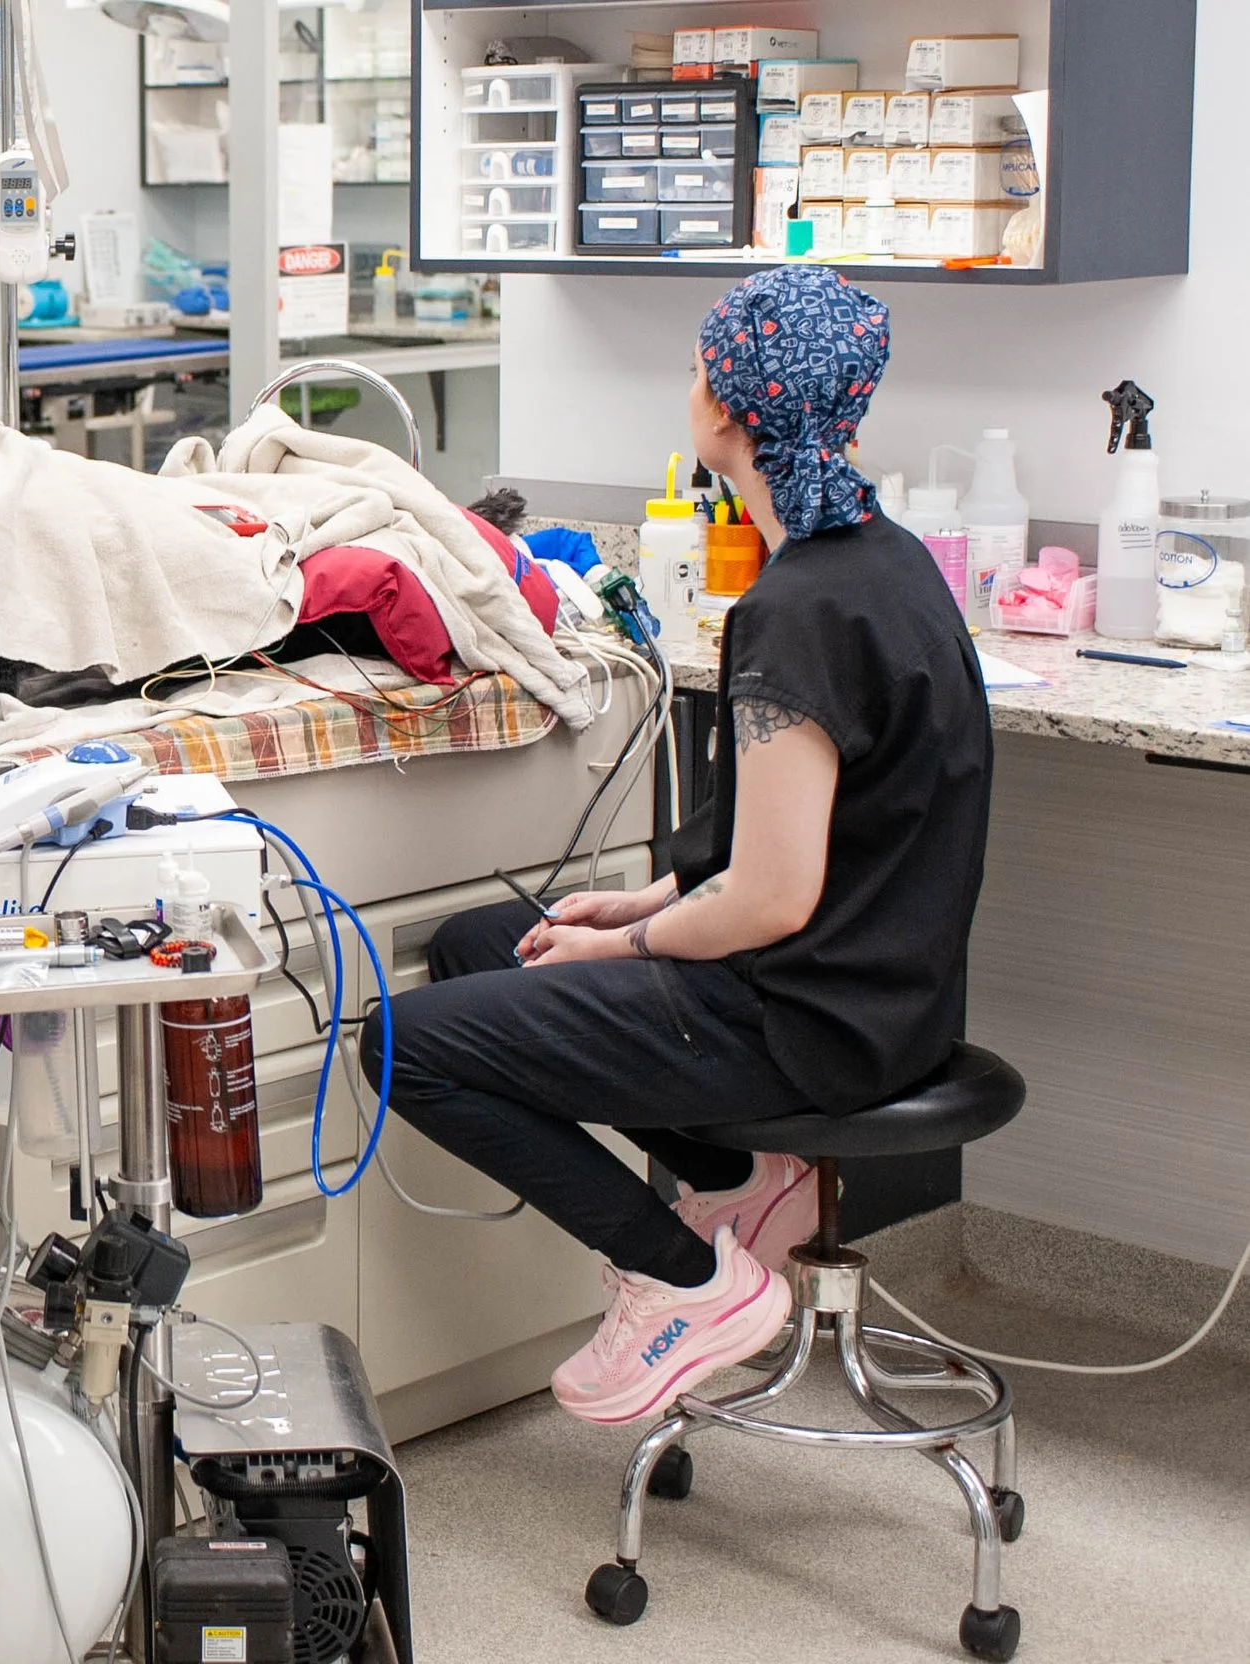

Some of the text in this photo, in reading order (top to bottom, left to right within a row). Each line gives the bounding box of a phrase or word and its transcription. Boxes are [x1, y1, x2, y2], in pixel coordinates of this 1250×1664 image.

[284, 250, 330, 270] DANGER
[1159, 552, 1193, 564] COTTON
[641, 1317, 690, 1368] HOKA
